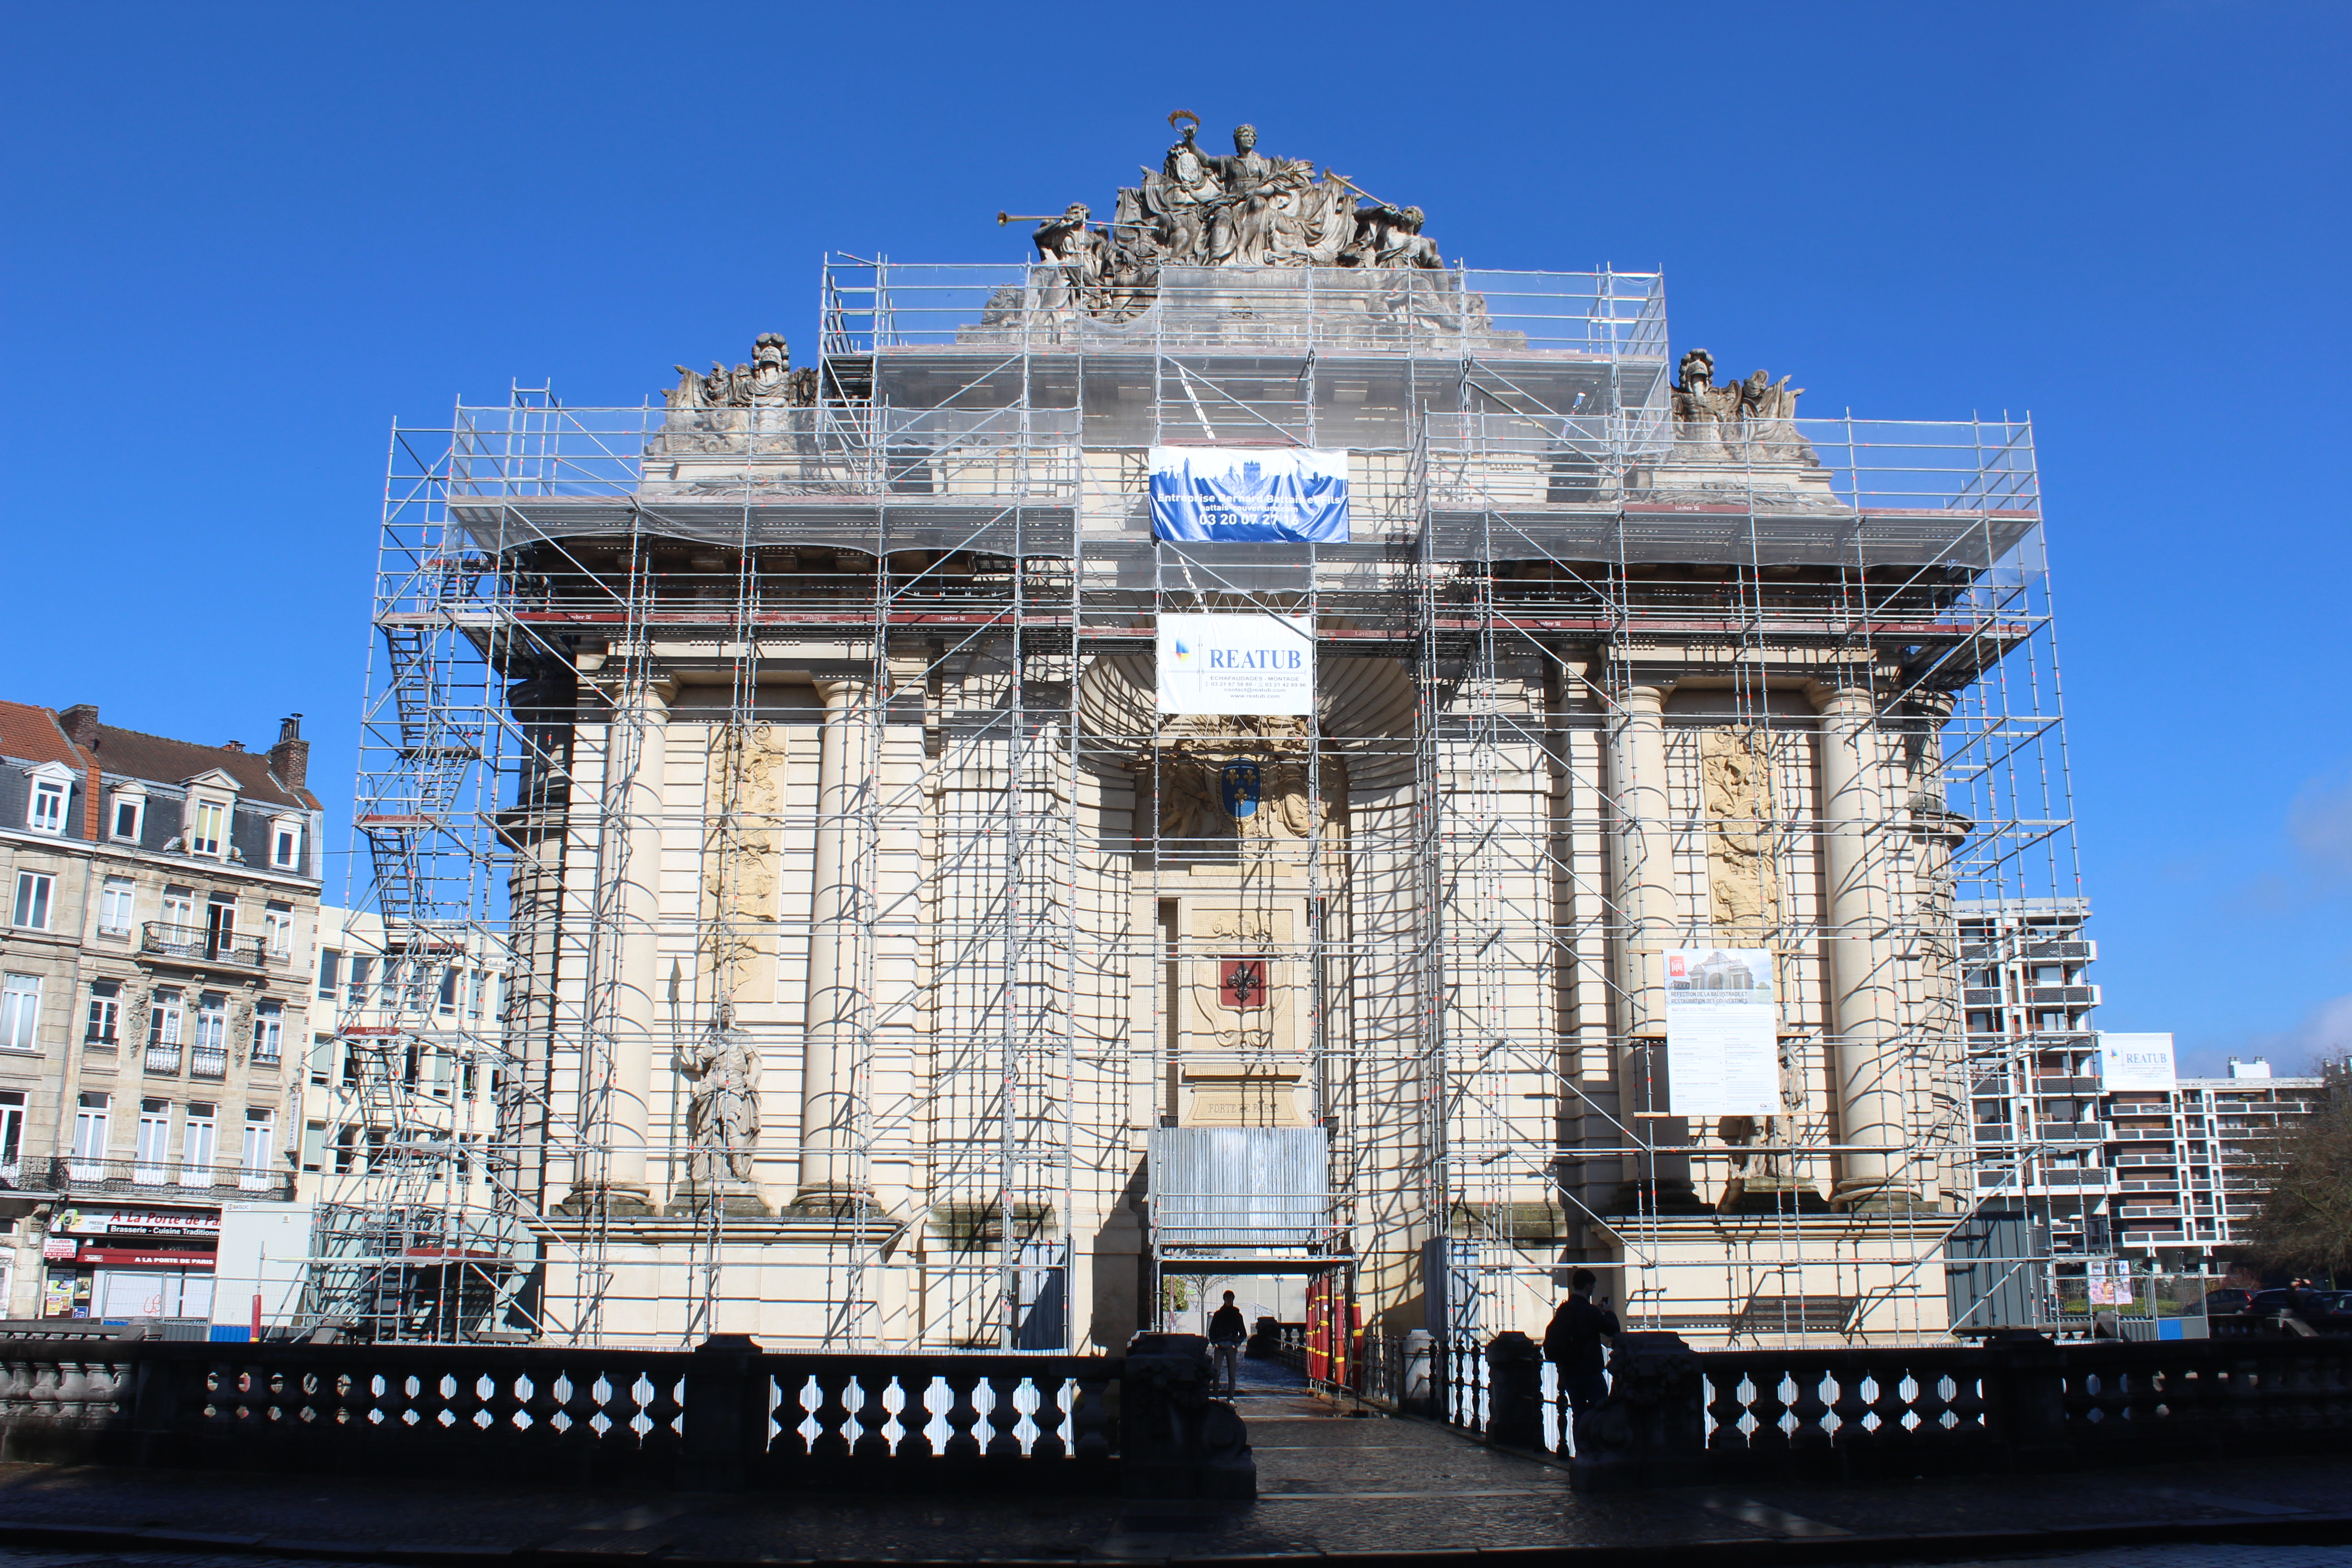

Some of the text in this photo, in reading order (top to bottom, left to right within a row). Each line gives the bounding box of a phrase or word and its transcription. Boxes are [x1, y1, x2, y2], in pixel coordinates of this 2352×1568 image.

[1158, 493, 1341, 505] Entreprise Bernard Battais et Fils
[1200, 504, 1298, 512] battais-couverture.com
[1199, 514, 1300, 525] 03 20 07 27 16
[1209, 649, 1301, 669] REATUB
[2126, 1053, 2167, 1063] REATUB
[1208, 1103, 1236, 1113] PORTE
[110, 1210, 121, 1222] A
[127, 1211, 142, 1223] La
[147, 1212, 181, 1224] Porte
[185, 1214, 200, 1225] de
[182, 1228, 220, 1236] Traditionn
